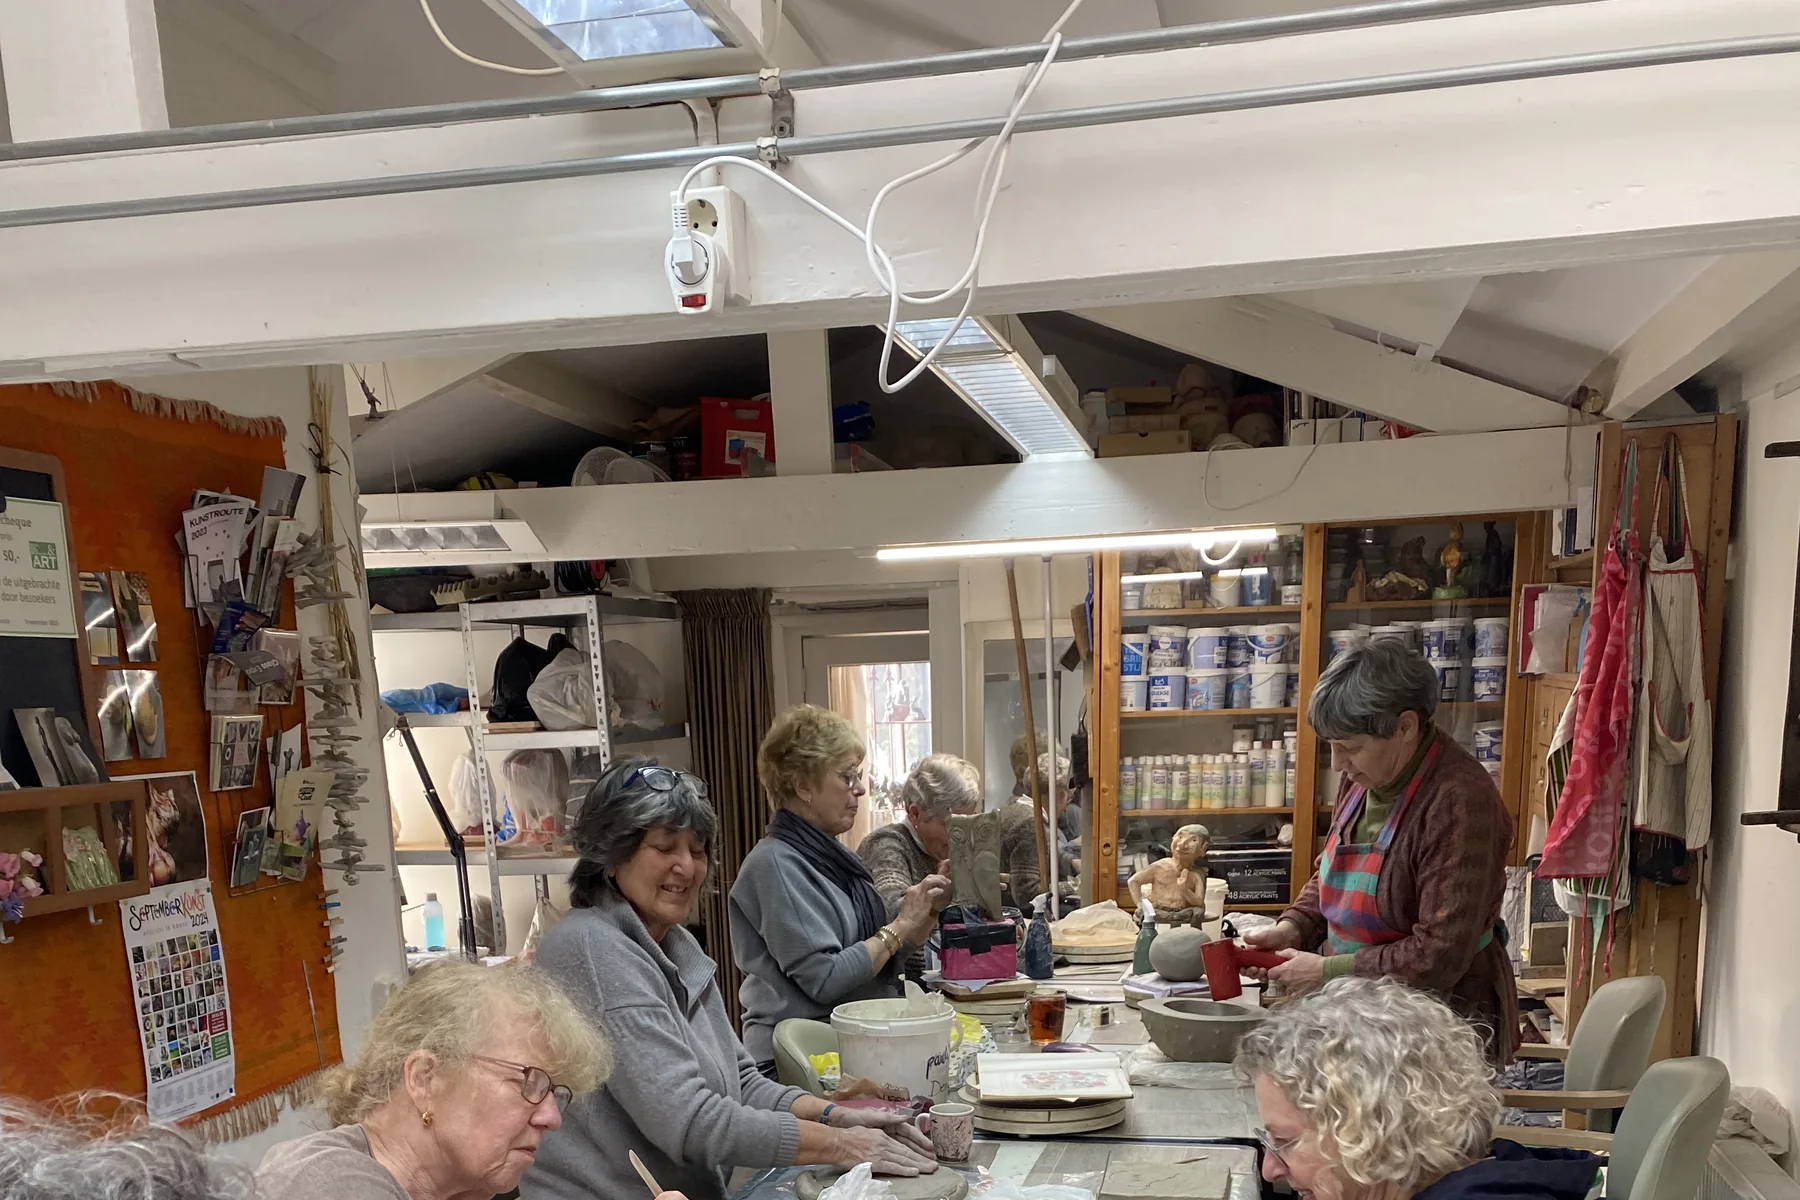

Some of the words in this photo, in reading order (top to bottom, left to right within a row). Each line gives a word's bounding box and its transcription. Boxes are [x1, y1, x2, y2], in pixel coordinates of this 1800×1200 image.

[189, 508, 245, 528] KUNSTROUTE
[191, 527, 207, 540] 2023
[33, 555, 57, 569] ART
[1244, 868, 1252, 877] 12
[1227, 891, 1239, 900] 48
[191, 911, 209, 928] 2024
